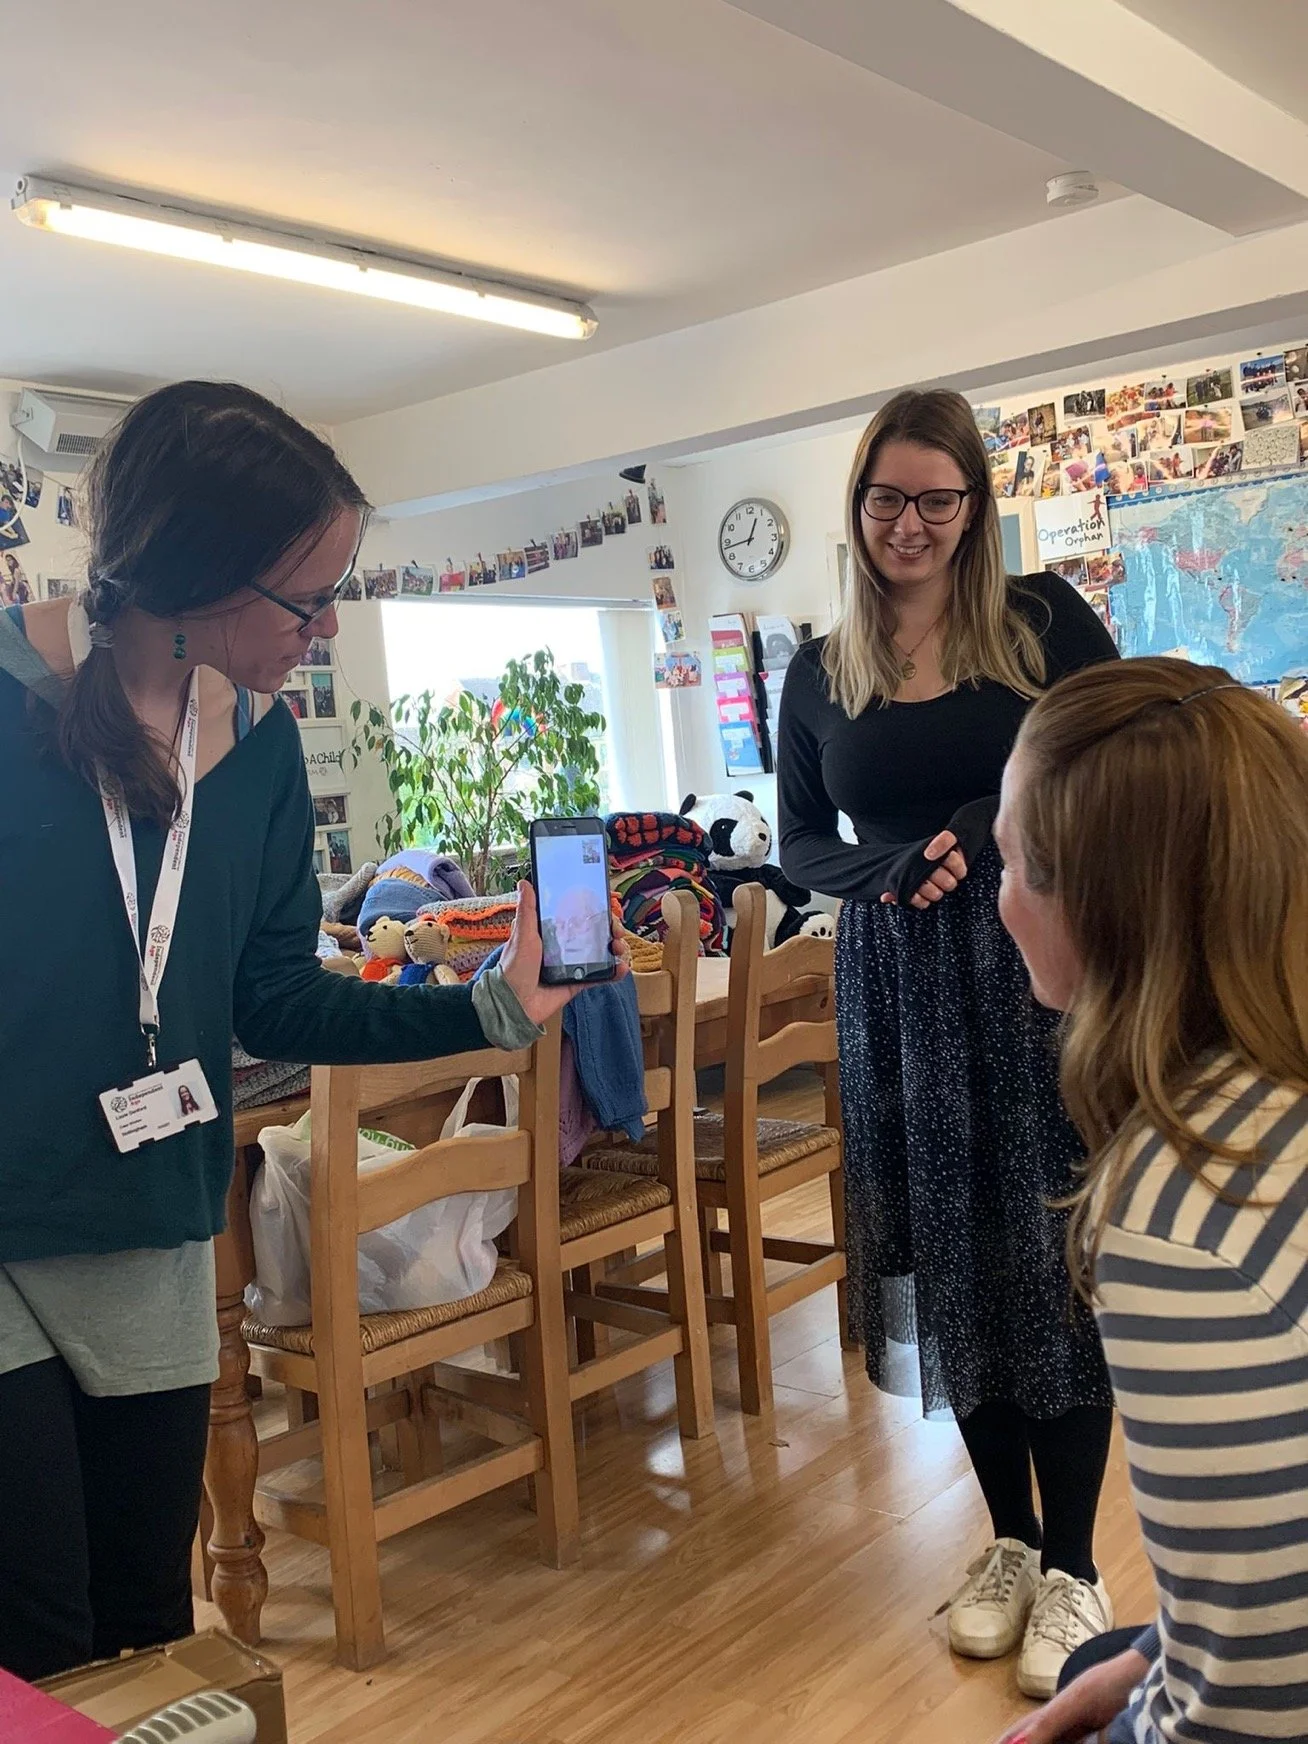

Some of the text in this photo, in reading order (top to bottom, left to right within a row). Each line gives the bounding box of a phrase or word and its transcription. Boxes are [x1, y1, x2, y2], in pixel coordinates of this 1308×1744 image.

[745, 506, 754, 515] 12
[767, 519, 773, 527] 2
[727, 524, 735, 532] 10
[1038, 518, 1105, 544] Operation
[771, 533, 777, 541] 3
[1065, 532, 1104, 547] Orphan
[724, 538, 731, 546] 9
[728, 552, 736, 560] 8
[737, 562, 743, 570] 7
[748, 565, 755, 573] 6
